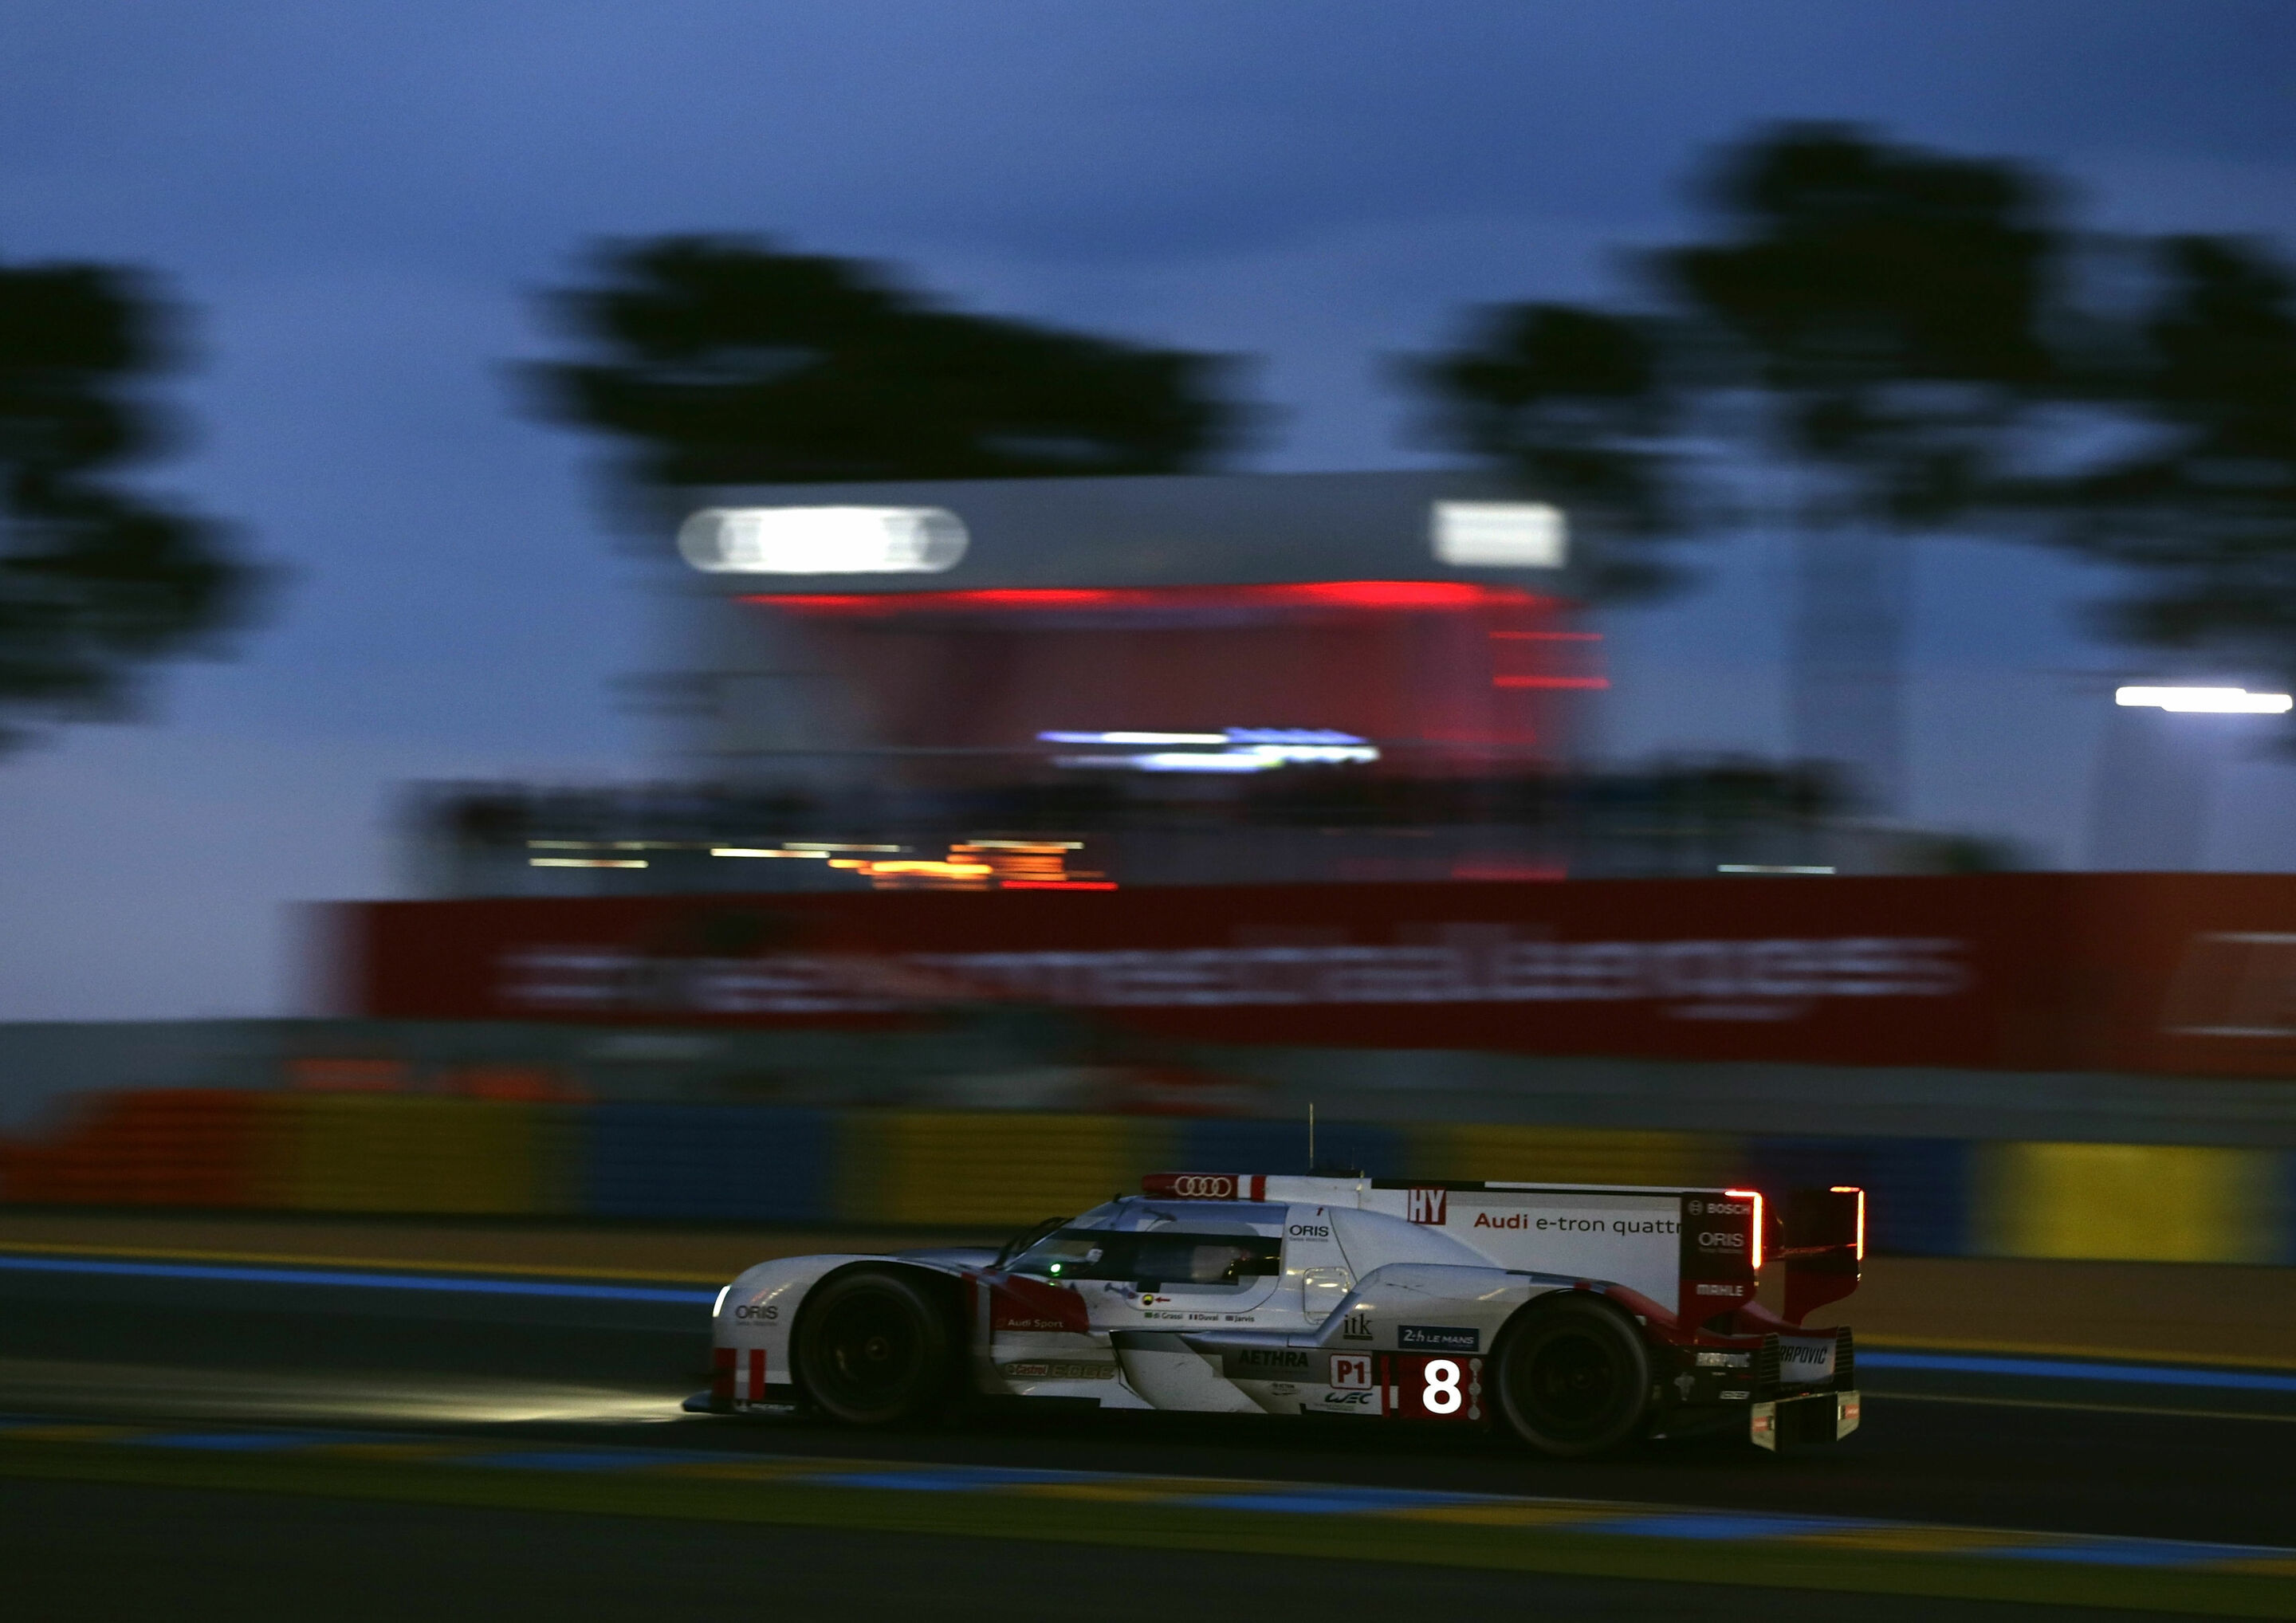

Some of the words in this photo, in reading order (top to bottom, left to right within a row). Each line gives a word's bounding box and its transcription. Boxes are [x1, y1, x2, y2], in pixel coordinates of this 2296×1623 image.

[1409, 1189, 1445, 1223] HY
[1707, 1203, 1751, 1215] BOSCH
[1289, 1224, 1329, 1237] ORIS
[1474, 1212, 1528, 1229] Audi
[1536, 1216, 1605, 1232] e-tron
[1613, 1220, 1682, 1236] quattr
[1698, 1232, 1744, 1247] ORIS
[1696, 1283, 1744, 1297] MAHLE
[736, 1305, 778, 1319] ORIS
[1034, 1319, 1064, 1330] Sport
[1344, 1313, 1373, 1335] itk
[1426, 1334, 1441, 1343] LE
[1442, 1336, 1475, 1345] MANS
[1238, 1350, 1308, 1367] AETHRA
[1016, 1364, 1047, 1375] Castrol
[1337, 1360, 1365, 1384] P1
[1422, 1358, 1462, 1415] 8
[1325, 1392, 1373, 1405] WEC
